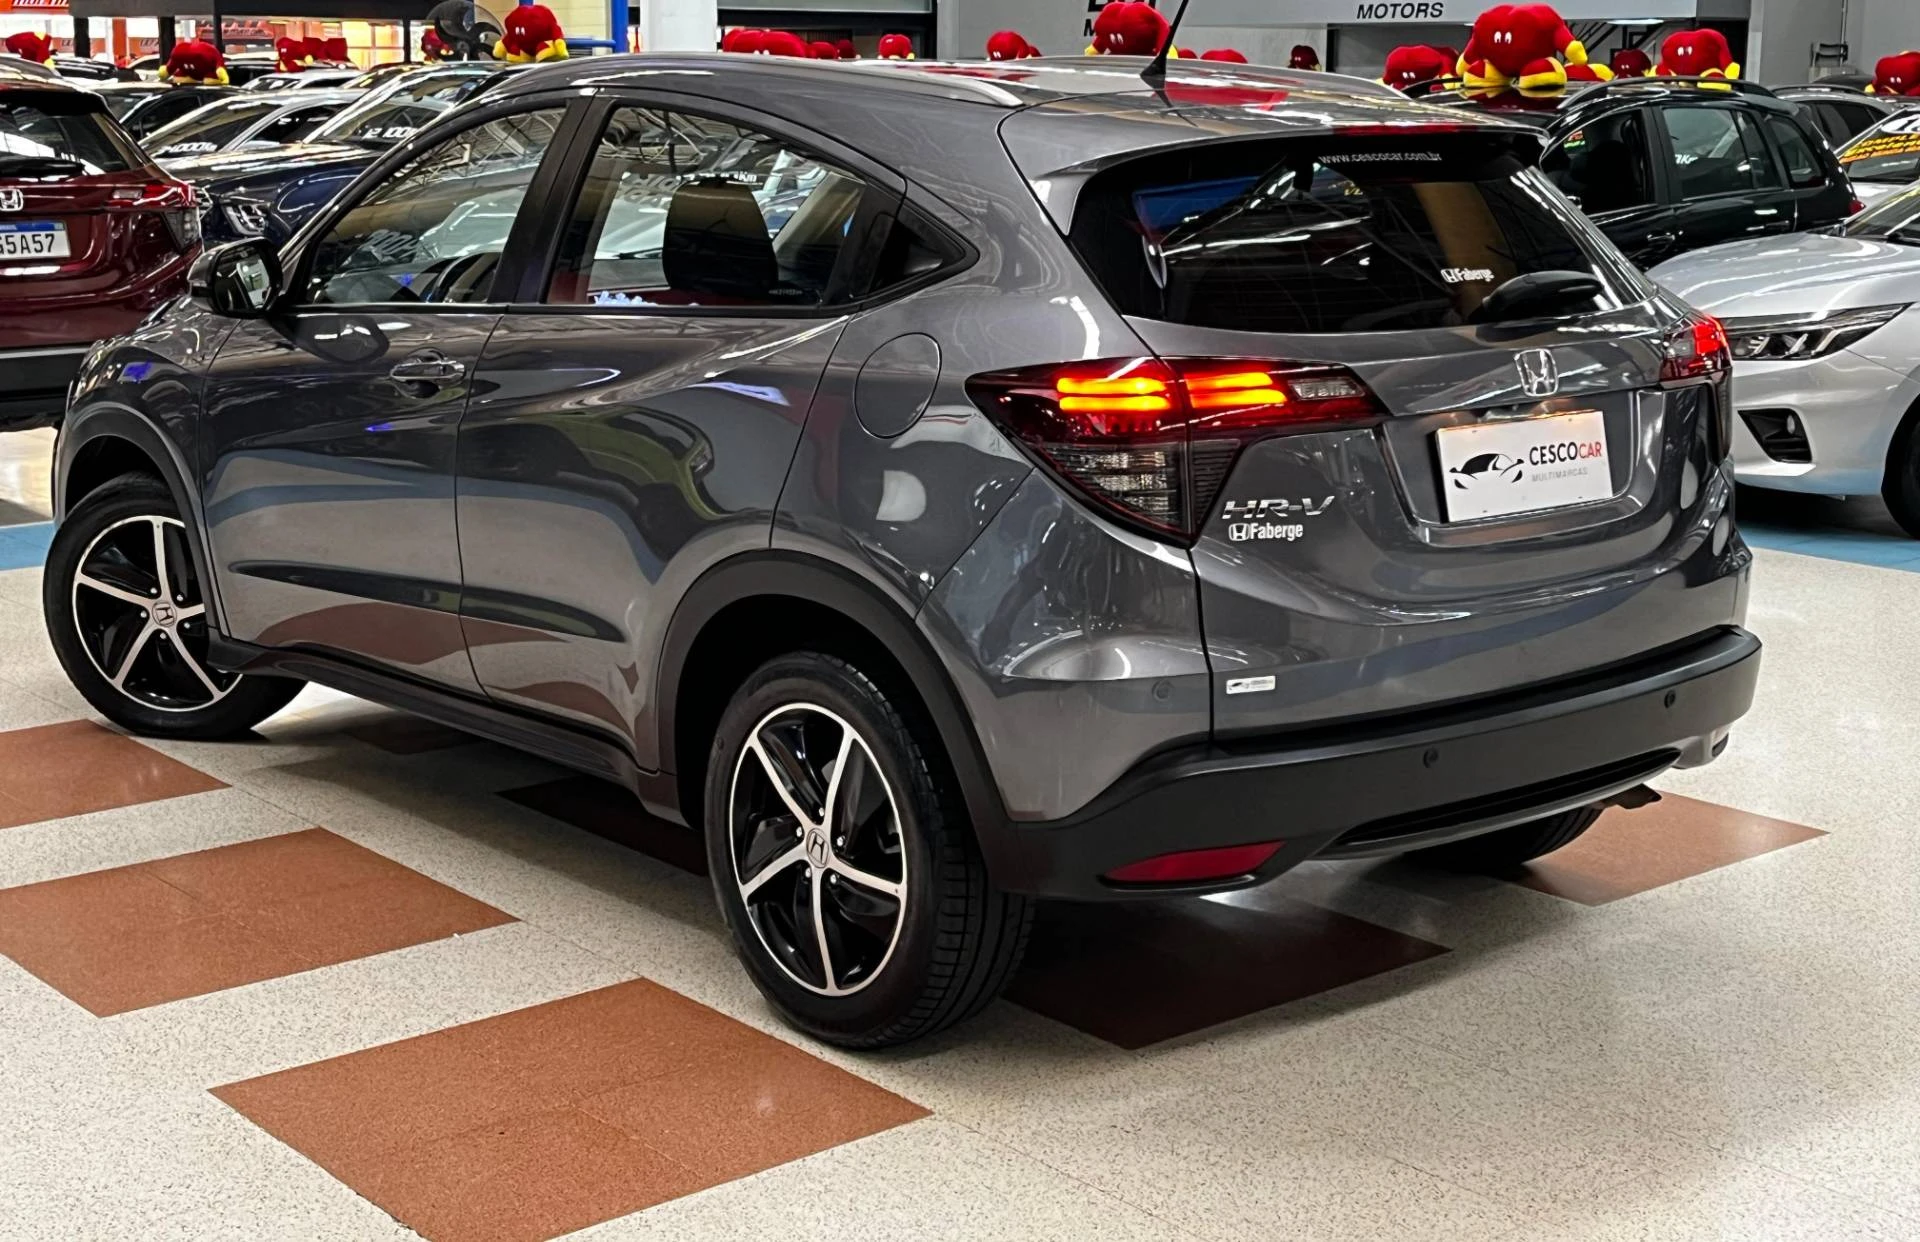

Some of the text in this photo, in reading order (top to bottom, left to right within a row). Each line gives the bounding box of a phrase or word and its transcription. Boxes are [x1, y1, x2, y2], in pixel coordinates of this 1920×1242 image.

[1356, 2, 1444, 19] MOTORS
[1318, 151, 1442, 164] www.cescocar.com.br
[1454, 267, 1495, 282] Faberge
[1529, 441, 1602, 466] CESCOCAR
[1531, 467, 1588, 483] MULTIMARCAS
[1221, 495, 1335, 520] HR-V
[1249, 521, 1304, 542] Faberge
